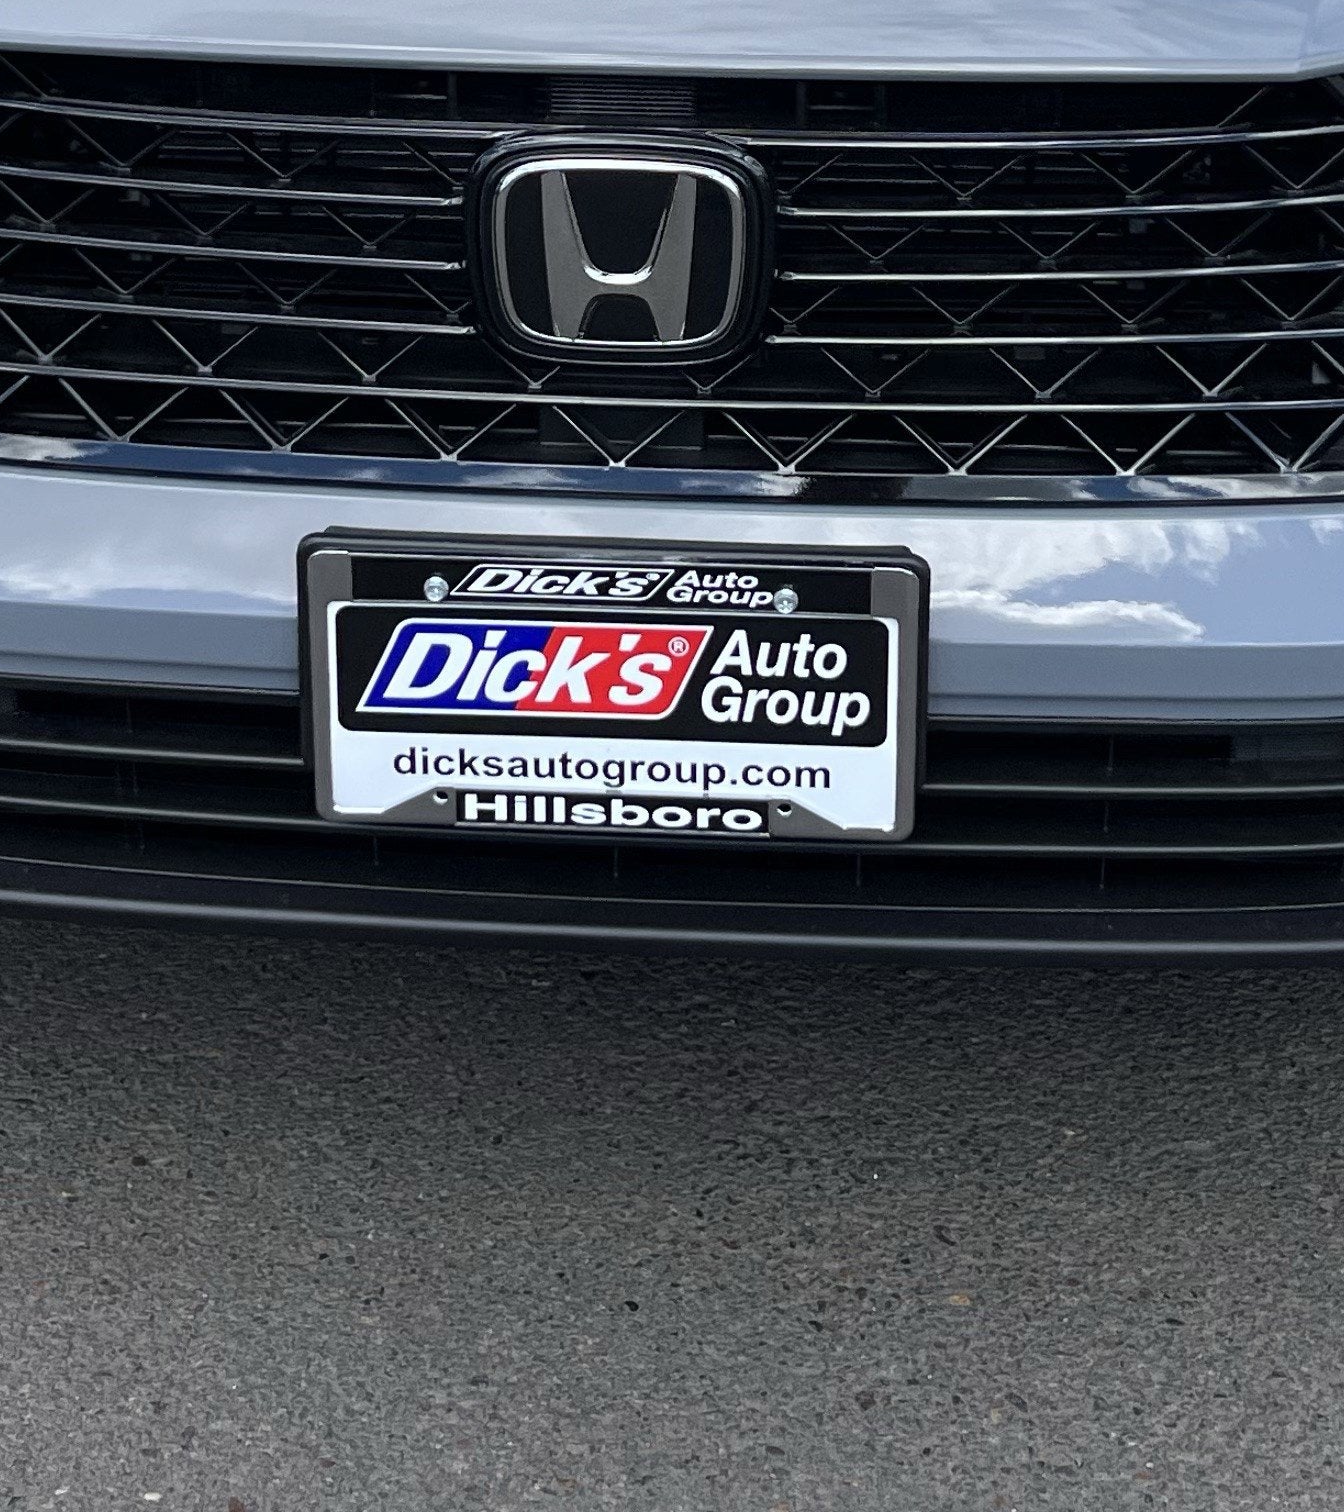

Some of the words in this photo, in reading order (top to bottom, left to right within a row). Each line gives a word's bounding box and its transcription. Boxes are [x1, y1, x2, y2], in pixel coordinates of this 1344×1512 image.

[666, 586, 774, 608] Group
[673, 569, 759, 589] Auto
[709, 629, 848, 680] Auto
[700, 675, 871, 737] Group
[393, 746, 832, 789] dicksautogroup.com
[464, 792, 763, 832] Hillsboro
